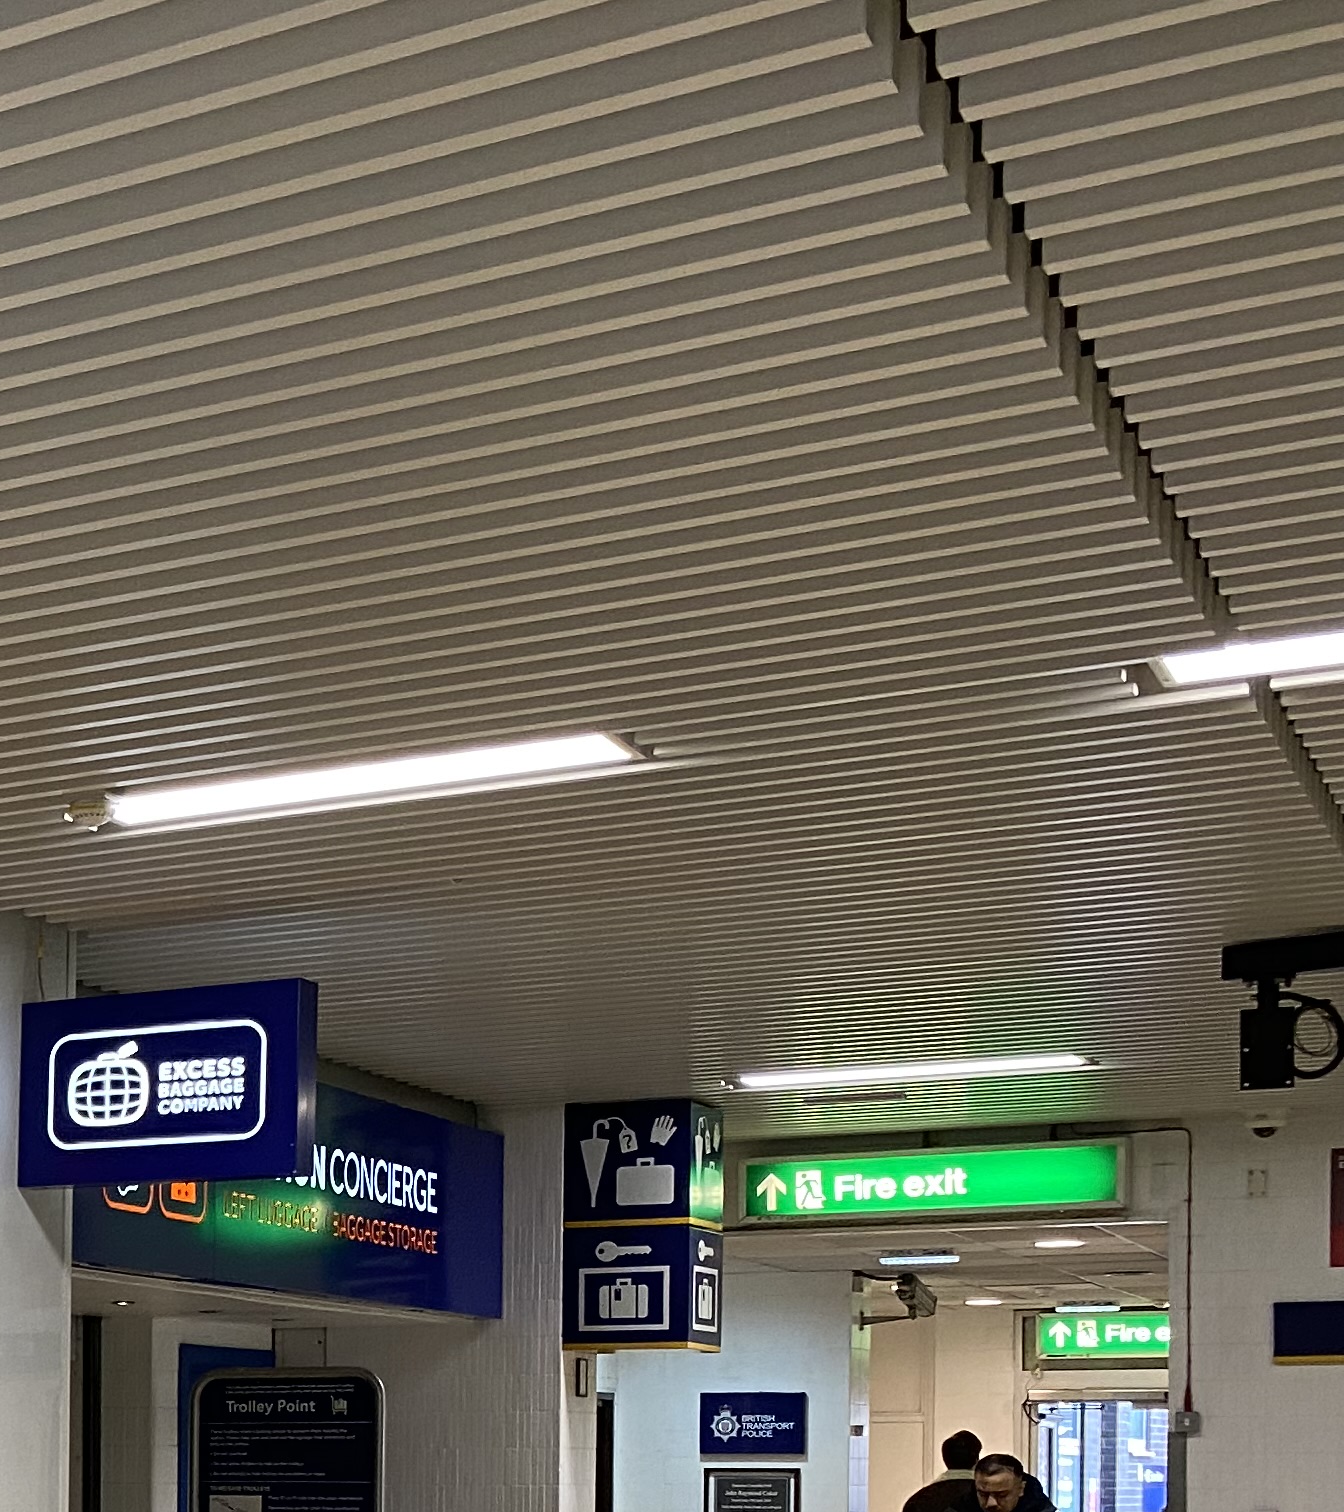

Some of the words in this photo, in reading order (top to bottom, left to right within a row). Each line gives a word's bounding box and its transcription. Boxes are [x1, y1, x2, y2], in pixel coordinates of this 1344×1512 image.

[158, 1056, 246, 1082] EXCESS
[158, 1078, 245, 1099] BAGGAGE
[158, 1095, 244, 1115] COMPANY
[330, 1148, 438, 1213] CONCIERGE
[834, 1174, 898, 1202] Fire
[902, 1168, 968, 1197] exit
[223, 1191, 256, 1220] LEFT
[258, 1197, 318, 1233] LUGGAGE
[333, 1212, 386, 1245] BAGGAGE
[388, 1222, 438, 1254] STORAGE
[1104, 1324, 1150, 1342] Fire
[226, 1400, 274, 1415] Trolley
[277, 1399, 316, 1412] Point
[741, 1430, 774, 1438] POLICE
[742, 1422, 795, 1430] TRANSPORT
